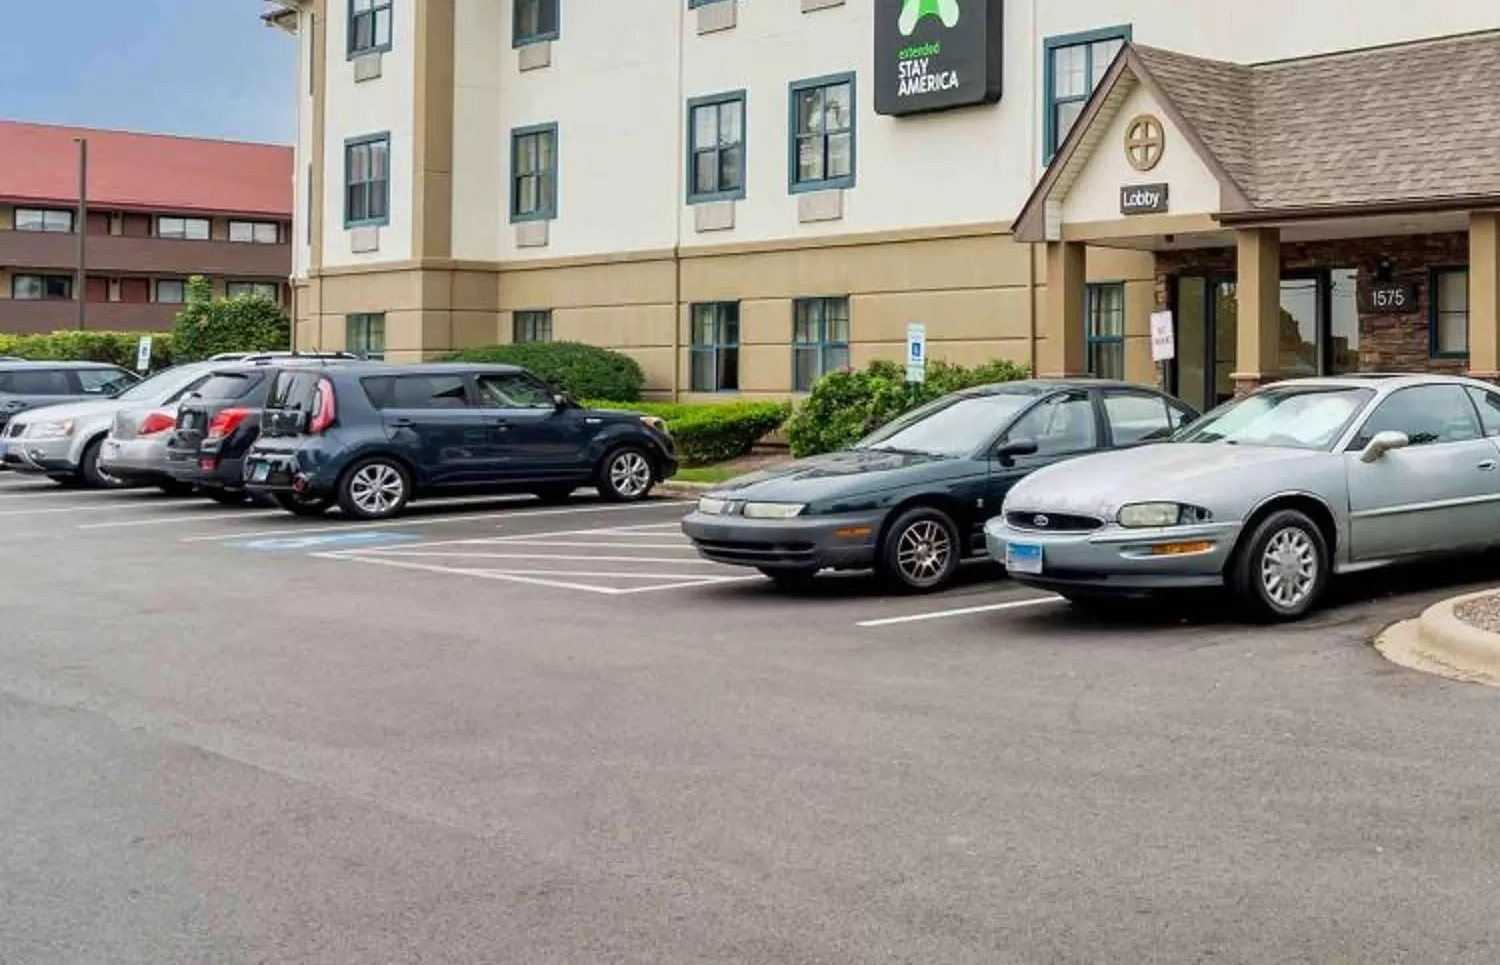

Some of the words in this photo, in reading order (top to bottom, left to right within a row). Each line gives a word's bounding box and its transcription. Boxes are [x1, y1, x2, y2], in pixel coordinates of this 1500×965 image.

[899, 41, 941, 60] extended
[898, 57, 929, 78] STAY
[897, 70, 959, 96] AMERICA
[1123, 190, 1160, 208] Lobby
[1372, 288, 1405, 307] 1575
